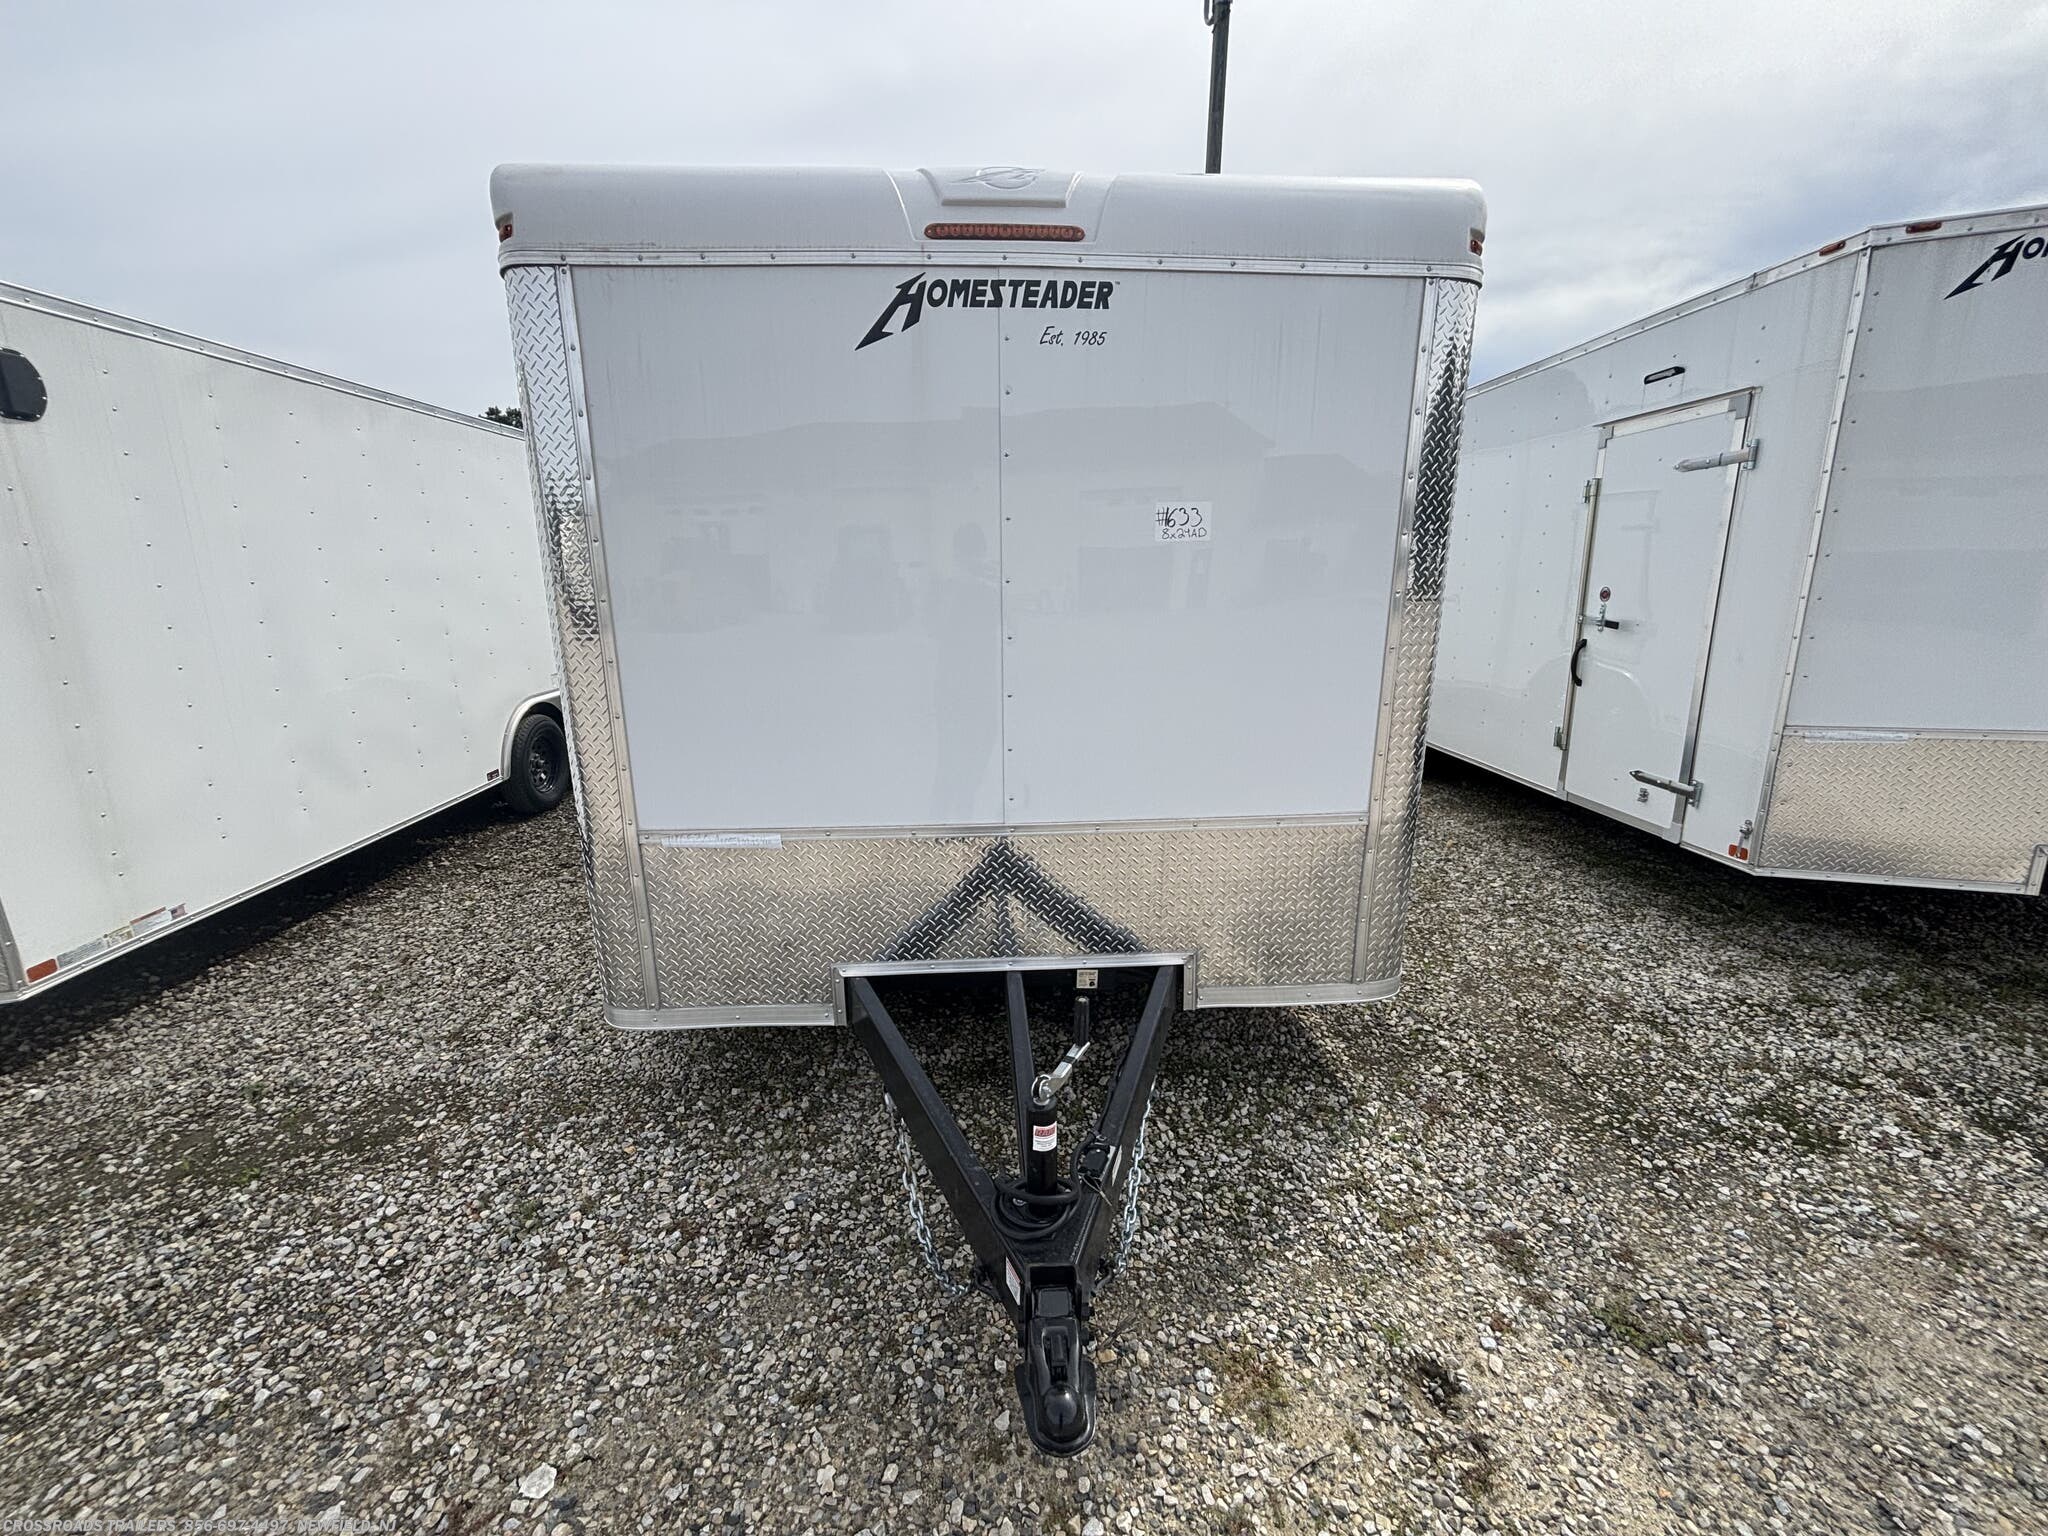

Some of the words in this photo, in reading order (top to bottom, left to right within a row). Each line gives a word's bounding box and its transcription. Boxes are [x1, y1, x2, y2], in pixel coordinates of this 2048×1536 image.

[855, 271, 1114, 351] HOMESTEADER
[1039, 325, 1064, 347] Est.
[1073, 330, 1107, 346] 1985
